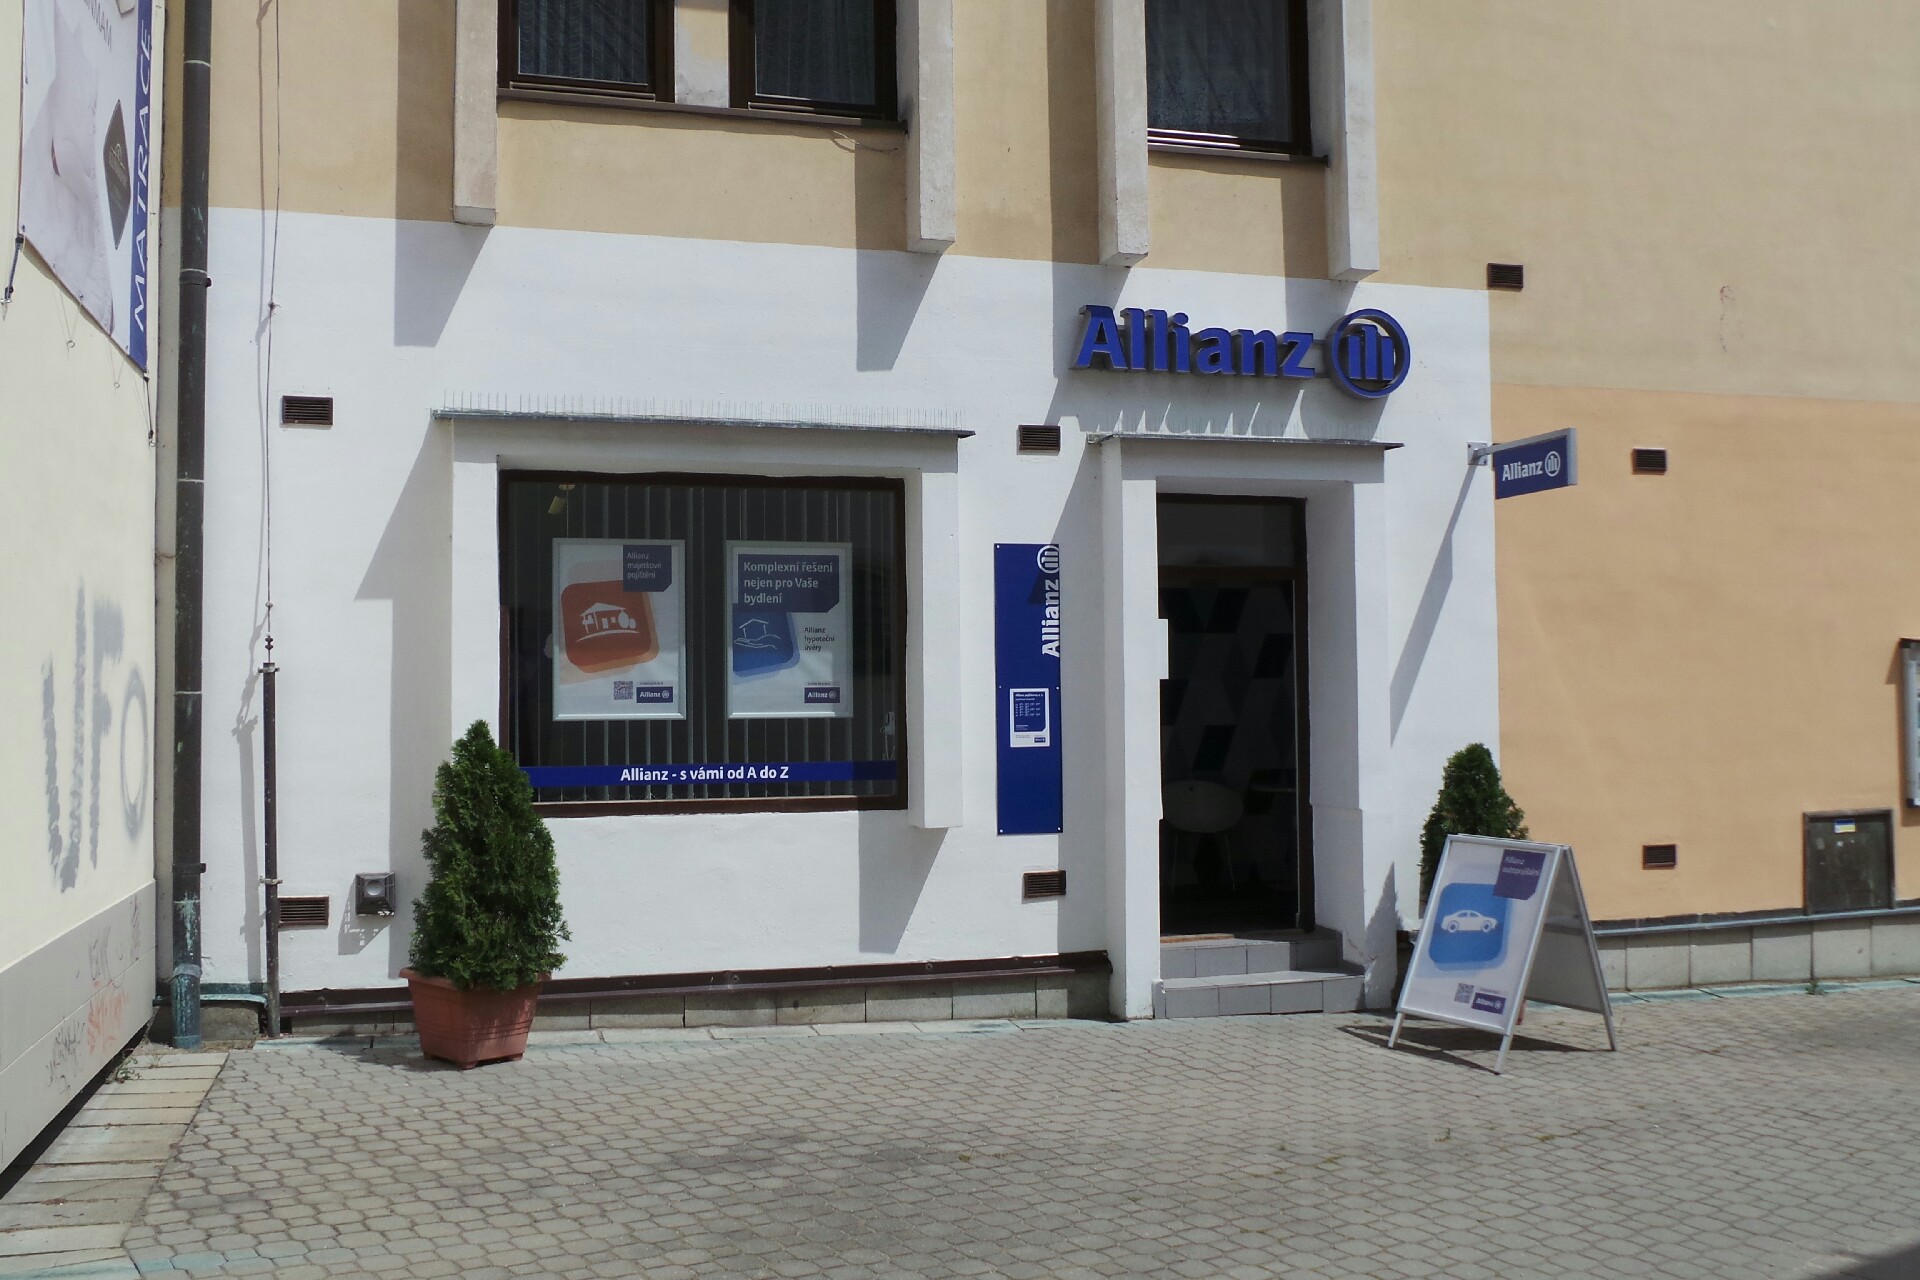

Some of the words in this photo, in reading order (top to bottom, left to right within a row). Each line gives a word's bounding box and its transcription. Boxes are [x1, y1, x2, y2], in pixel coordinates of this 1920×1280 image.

[133, 19, 152, 332] MATRACE
[1073, 304, 1316, 379] Allianz
[1501, 460, 1543, 482] Allianz
[626, 552, 650, 560] Allianz
[743, 561, 800, 574] Komplexní
[801, 561, 833, 573] řešení
[627, 570, 656, 580] pojištění
[743, 577, 773, 590] nejen
[775, 579, 793, 590] pro
[794, 577, 819, 588] Vaše
[744, 592, 783, 606] bydlení
[1041, 578, 1060, 658] Allianz
[804, 626, 826, 634] Allianz
[804, 635, 835, 643] hypoteční
[620, 767, 669, 781] Allianz
[679, 771, 687, 780] s
[689, 766, 724, 781] vámi
[727, 767, 744, 780] od
[746, 767, 758, 780] A
[760, 766, 777, 780] do
[780, 766, 789, 779] Z
